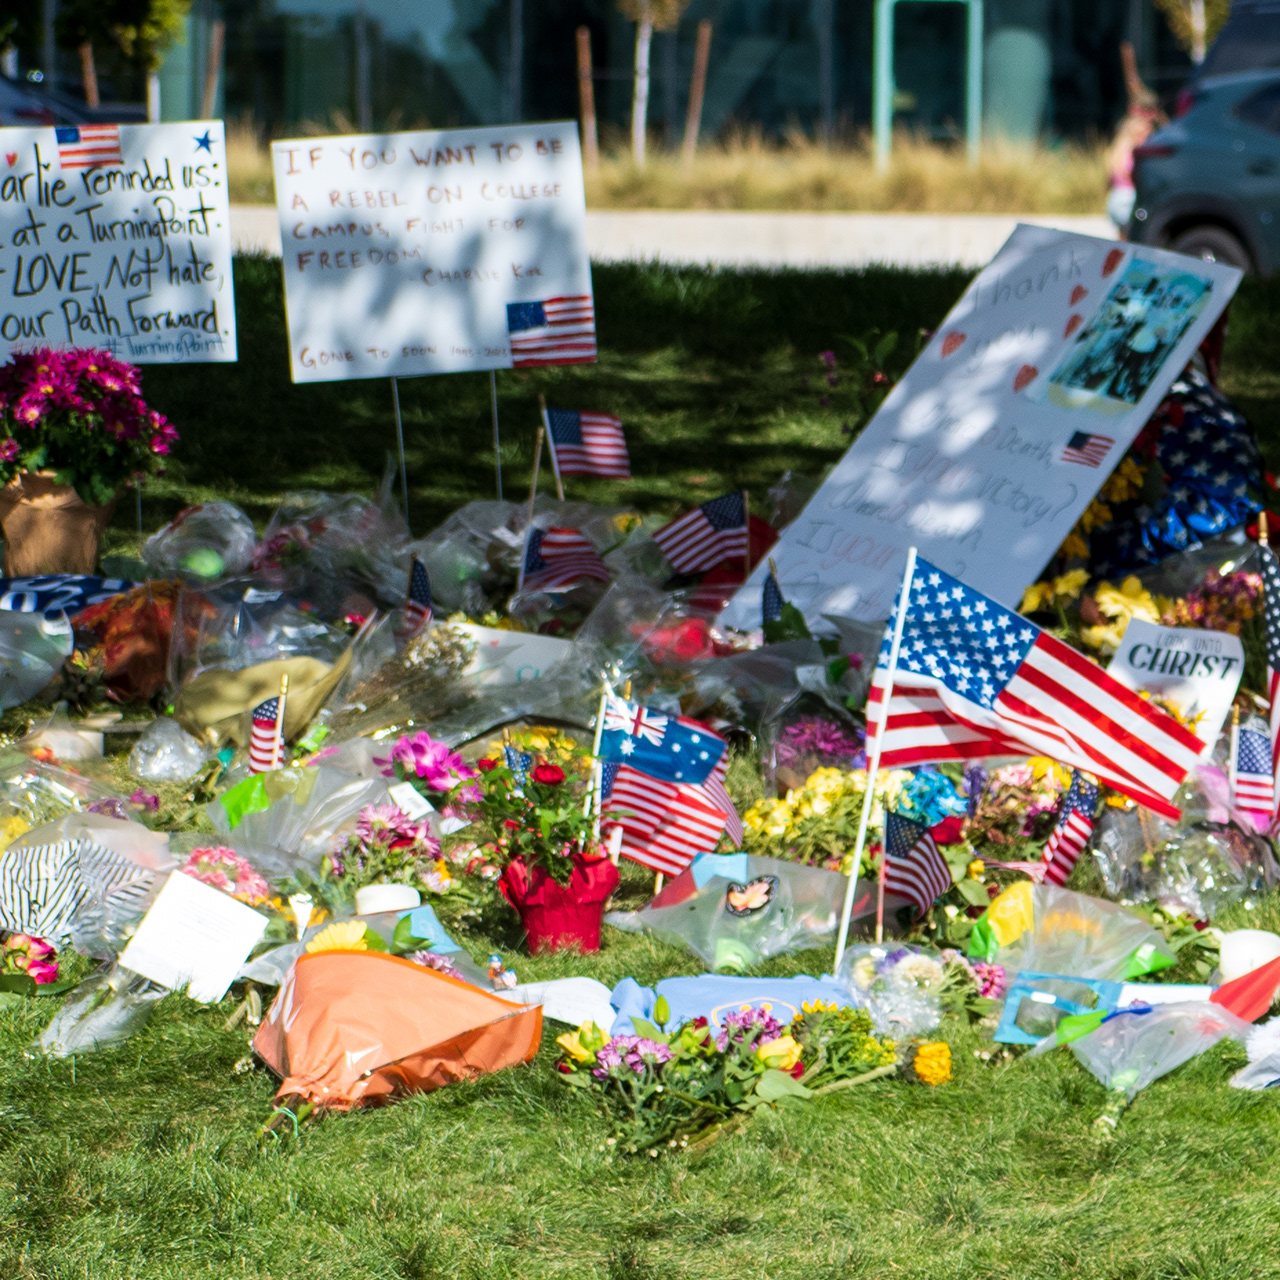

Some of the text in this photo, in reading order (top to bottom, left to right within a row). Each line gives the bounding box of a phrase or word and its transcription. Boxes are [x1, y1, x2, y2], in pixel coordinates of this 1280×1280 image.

[1, 143, 221, 208] arlie reminded us:
[284, 137, 564, 176] IF YOU WANT TO BE
[291, 182, 563, 212] A REBEL ON COLLEGE
[12, 208, 47, 247] at
[57, 223, 80, 243] a
[291, 217, 526, 241] CAMPUS, FIGHT FOR
[13, 240, 225, 298] LOVE, Not hate,
[296, 248, 422, 273] FREEDOM
[1, 310, 54, 341] our
[61, 294, 122, 343] Path
[299, 345, 355, 369] GONE
[365, 347, 390, 360] TO
[401, 345, 439, 359] SOON
[1128, 643, 1240, 680] CHRIST
